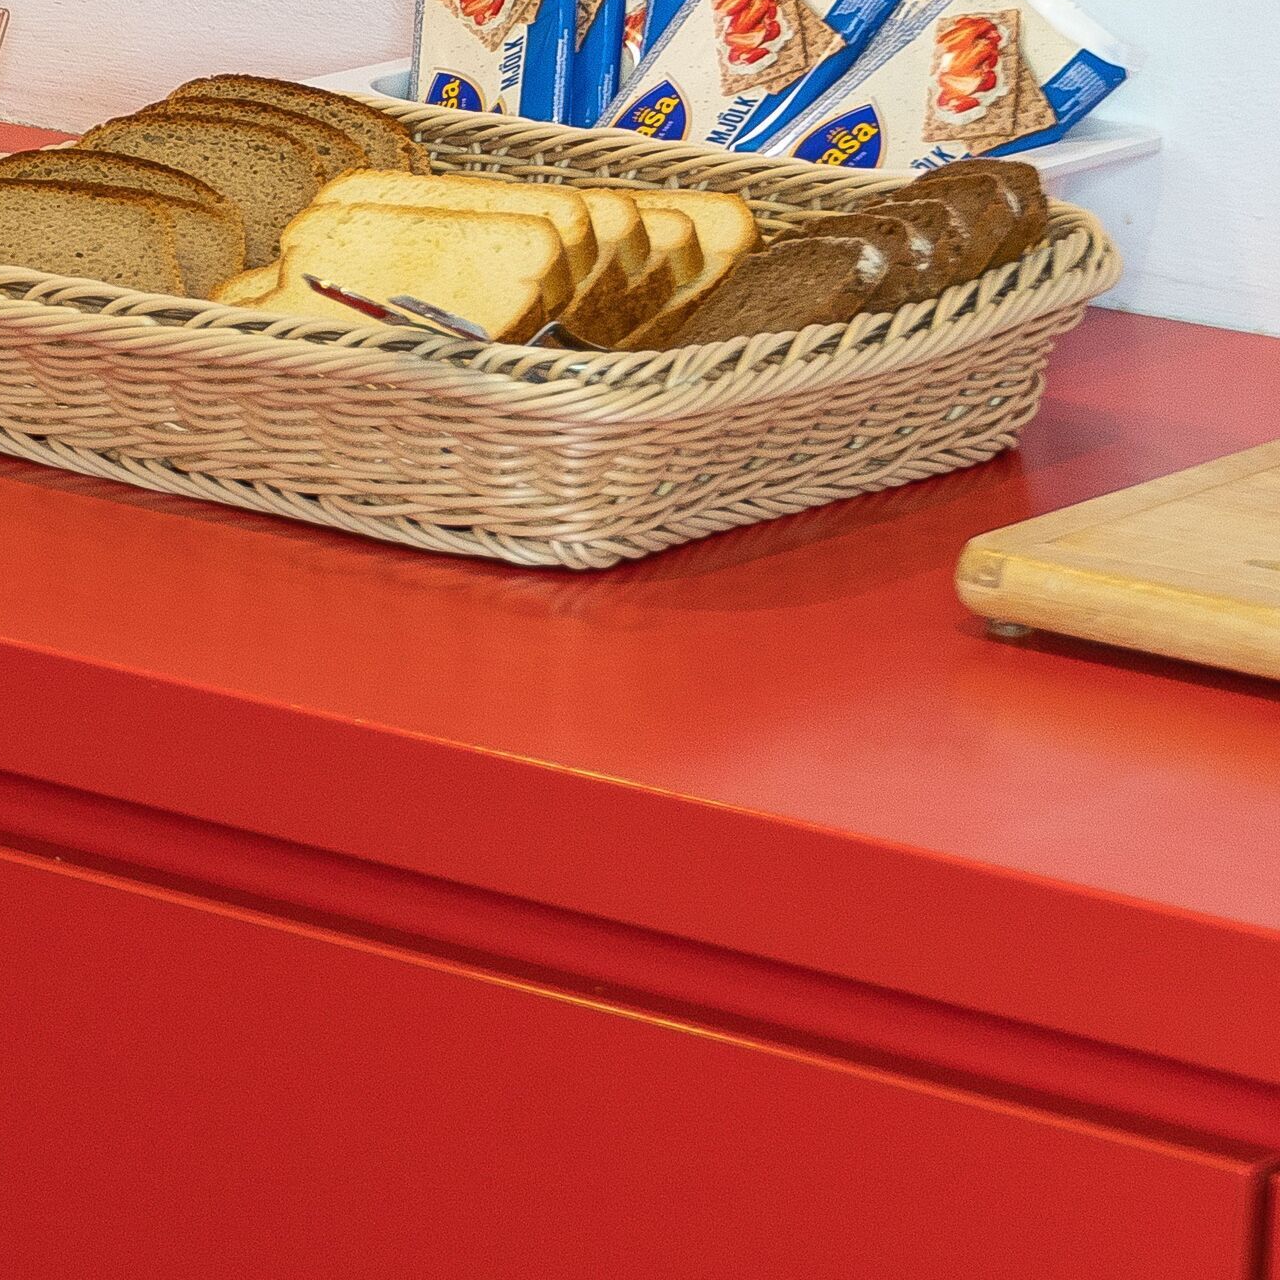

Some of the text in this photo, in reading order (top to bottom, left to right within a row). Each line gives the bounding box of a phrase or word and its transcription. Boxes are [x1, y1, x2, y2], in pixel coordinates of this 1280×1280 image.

[498, 35, 525, 92] MJÖLK
[636, 95, 681, 138] asa
[705, 95, 760, 146] MJÖLK
[815, 122, 880, 166] asa
